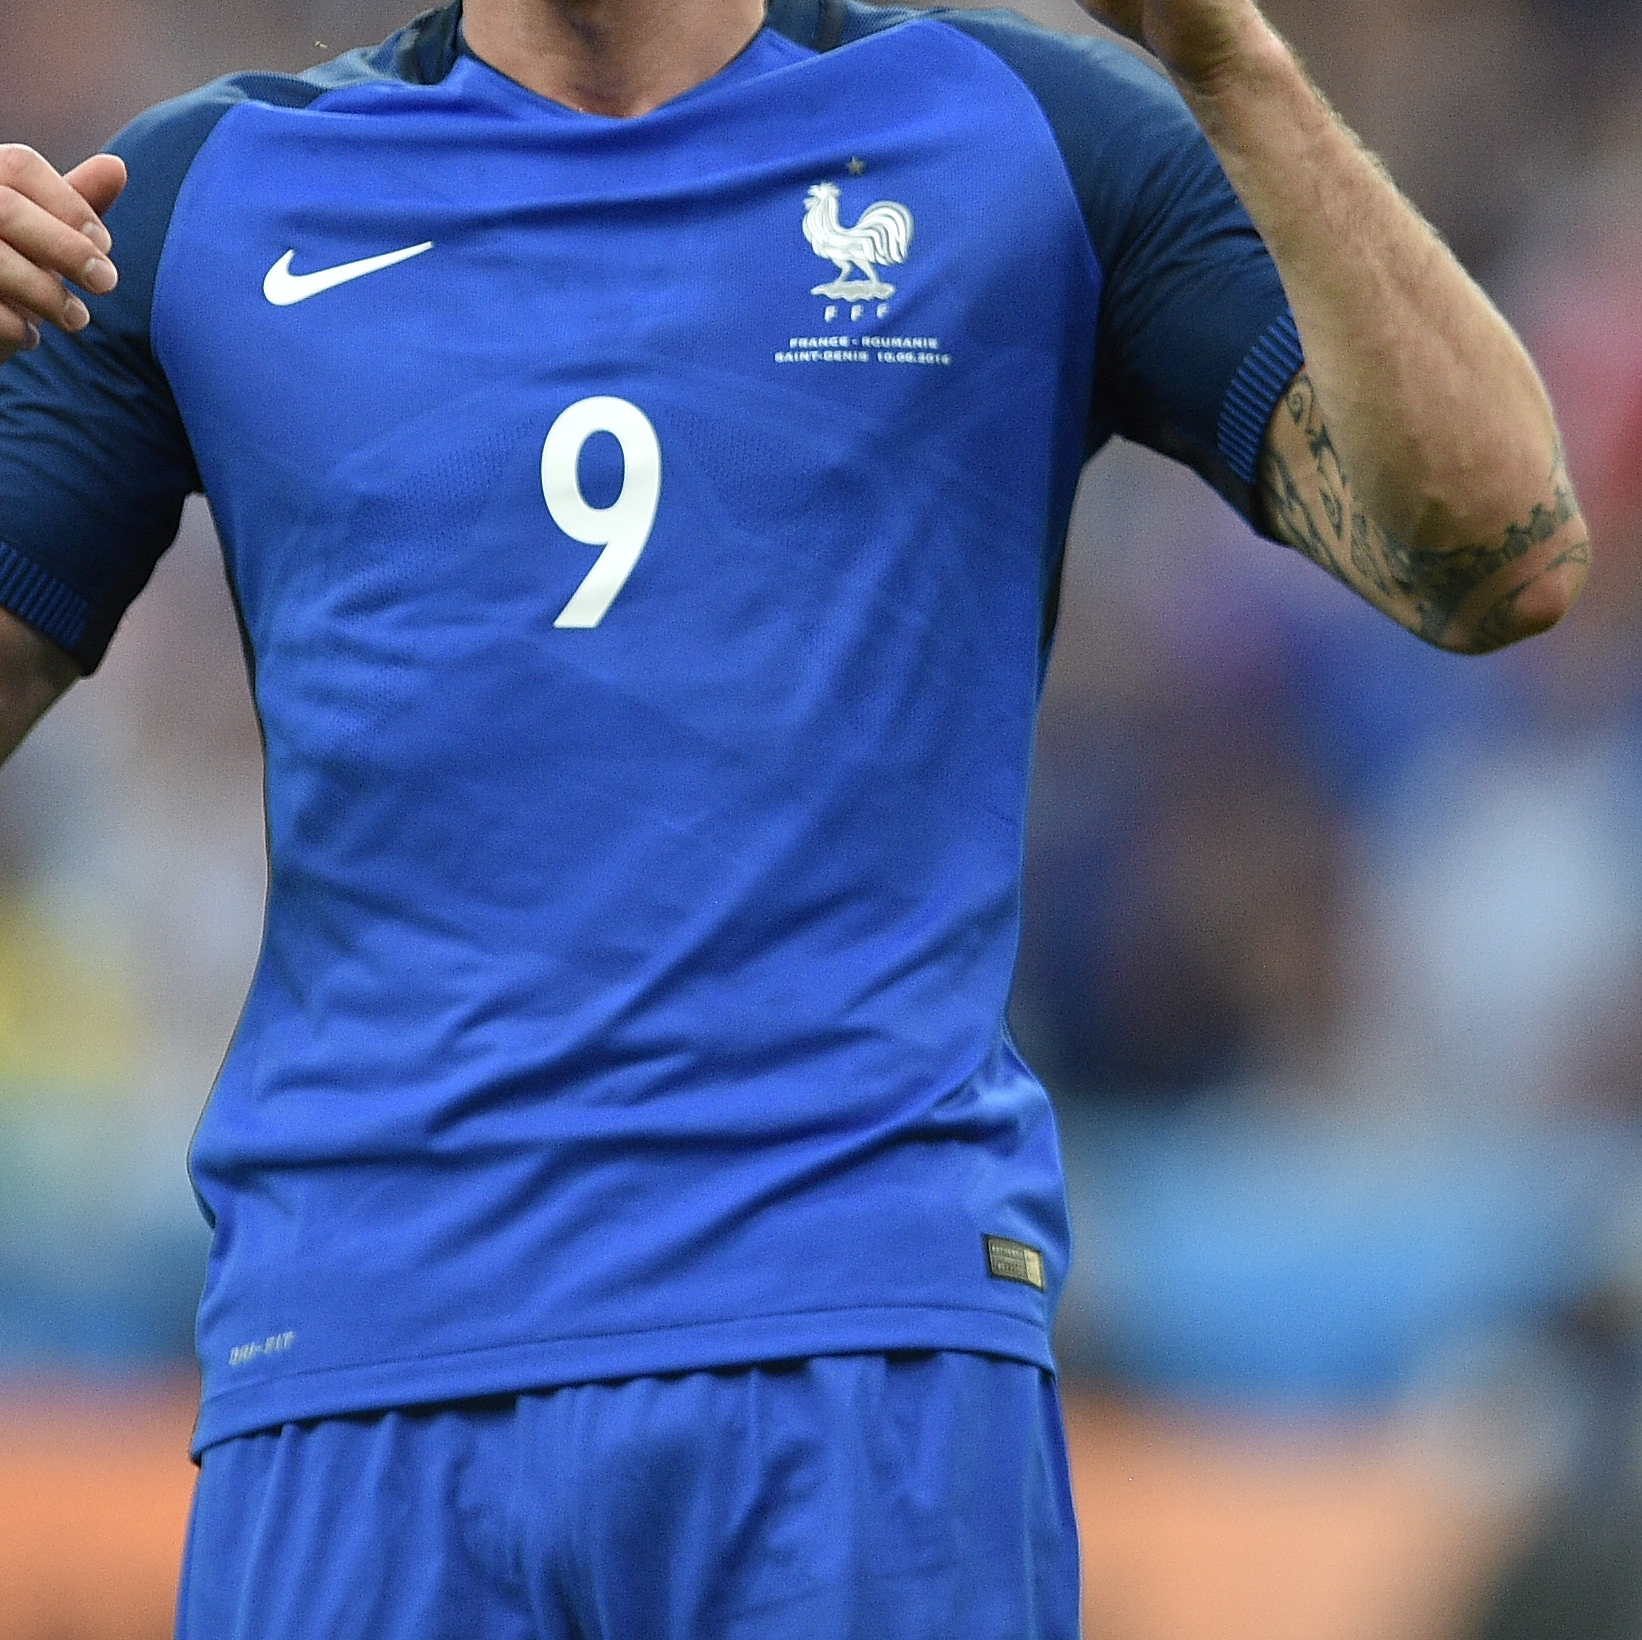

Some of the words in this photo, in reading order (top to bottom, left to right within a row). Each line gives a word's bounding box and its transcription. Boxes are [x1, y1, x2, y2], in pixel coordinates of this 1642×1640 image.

[789, 336, 850, 348] FRANCE
[861, 336, 938, 349] ROUMANIE
[774, 350, 868, 363] SAINT-DENIS
[540, 395, 662, 628] 9
